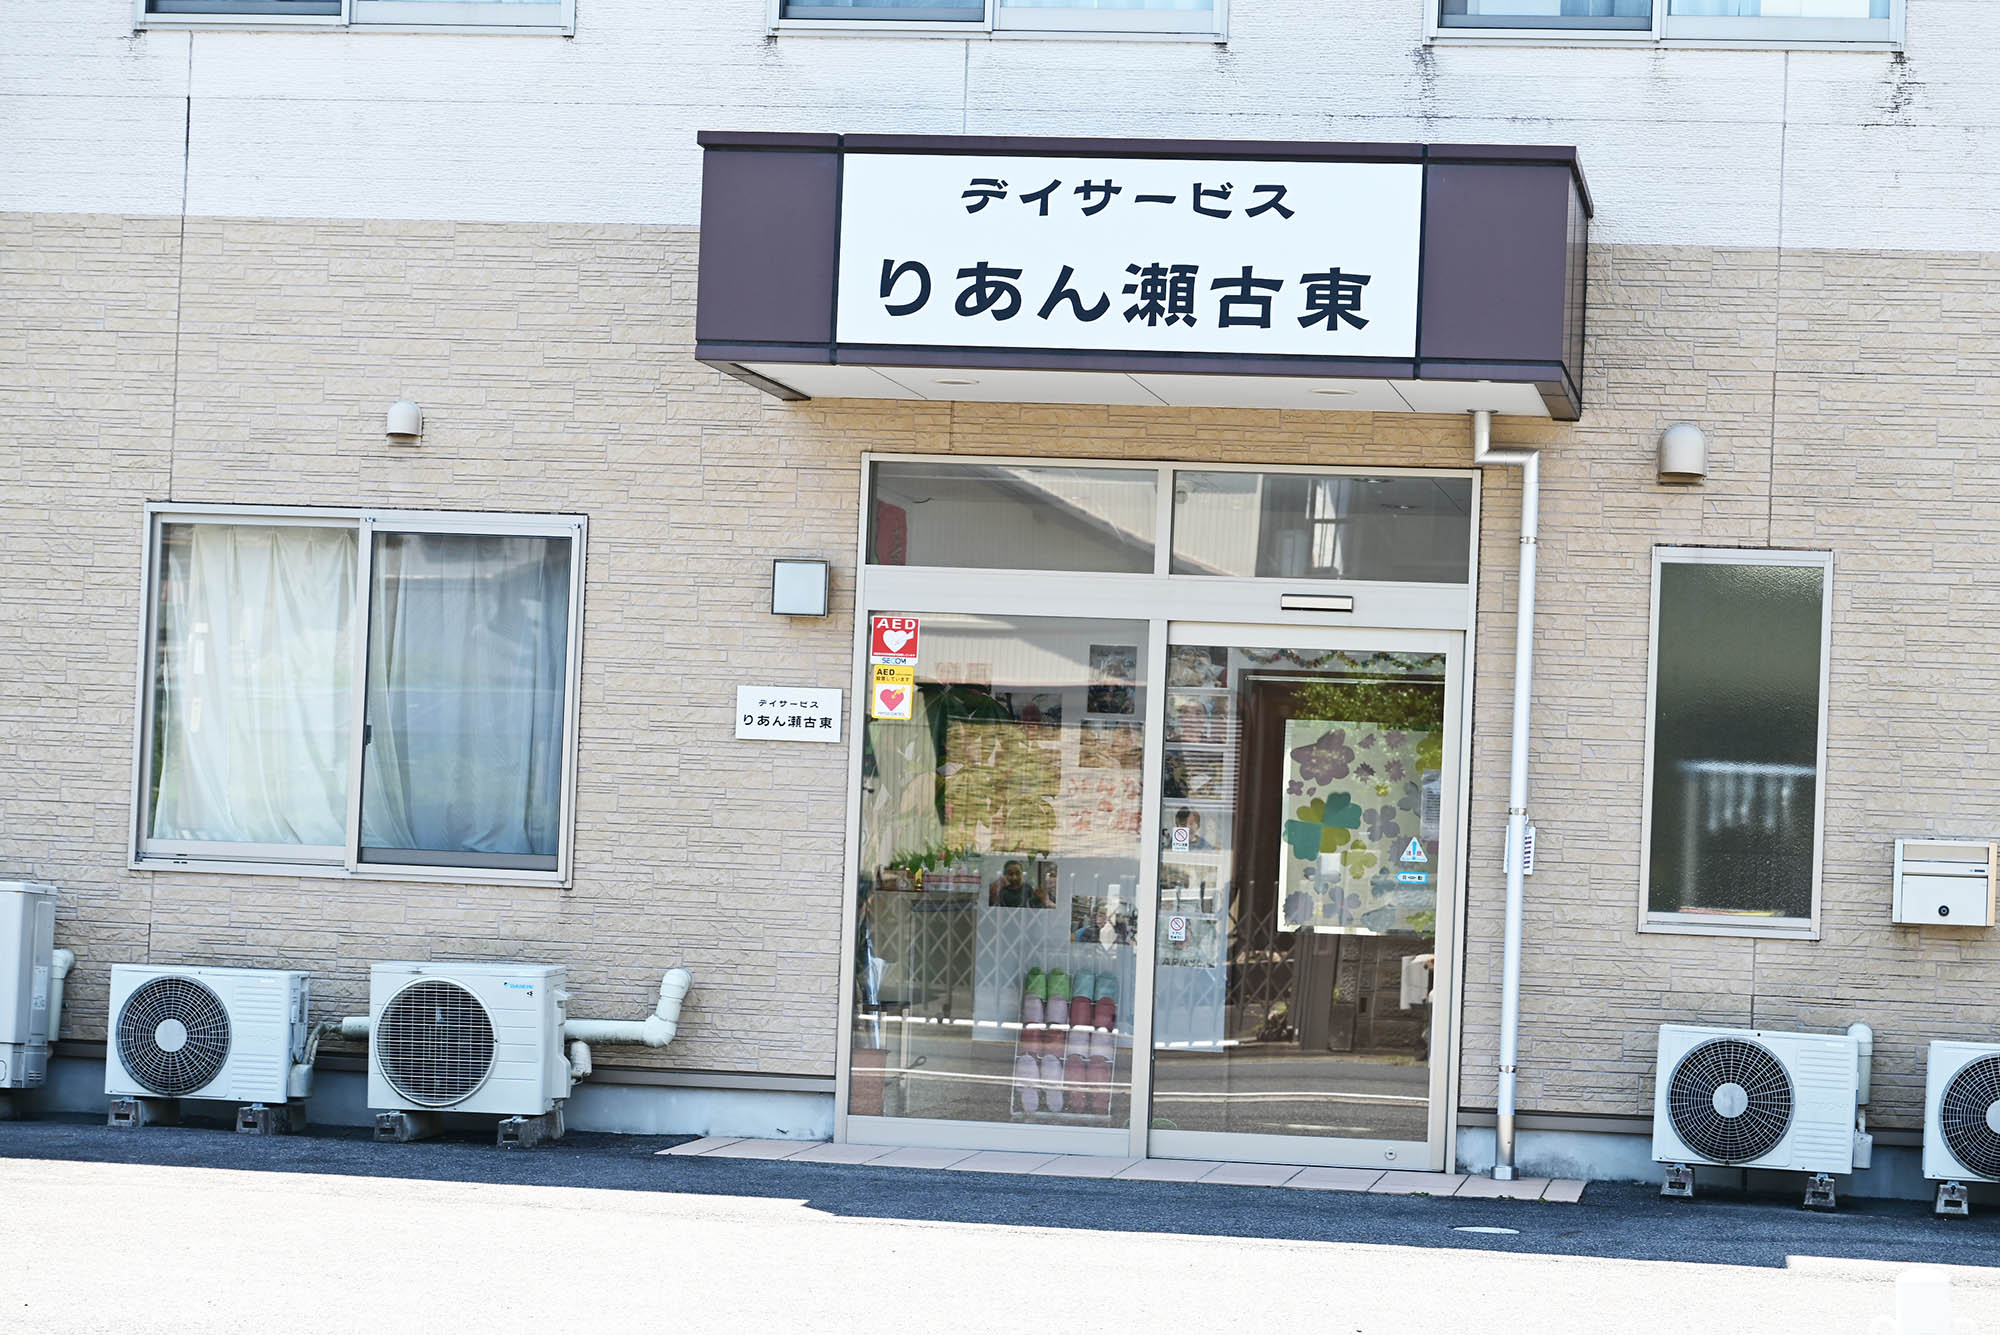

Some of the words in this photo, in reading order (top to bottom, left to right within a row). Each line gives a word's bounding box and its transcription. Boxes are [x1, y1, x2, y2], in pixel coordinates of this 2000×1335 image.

[961, 178, 1295, 219] デイサービス
[879, 258, 1372, 332] りあん瀬古東
[877, 618, 917, 630] AED
[881, 657, 907, 665] SECOM
[876, 668, 896, 676] AED
[743, 713, 833, 729] りあん瀬古東
